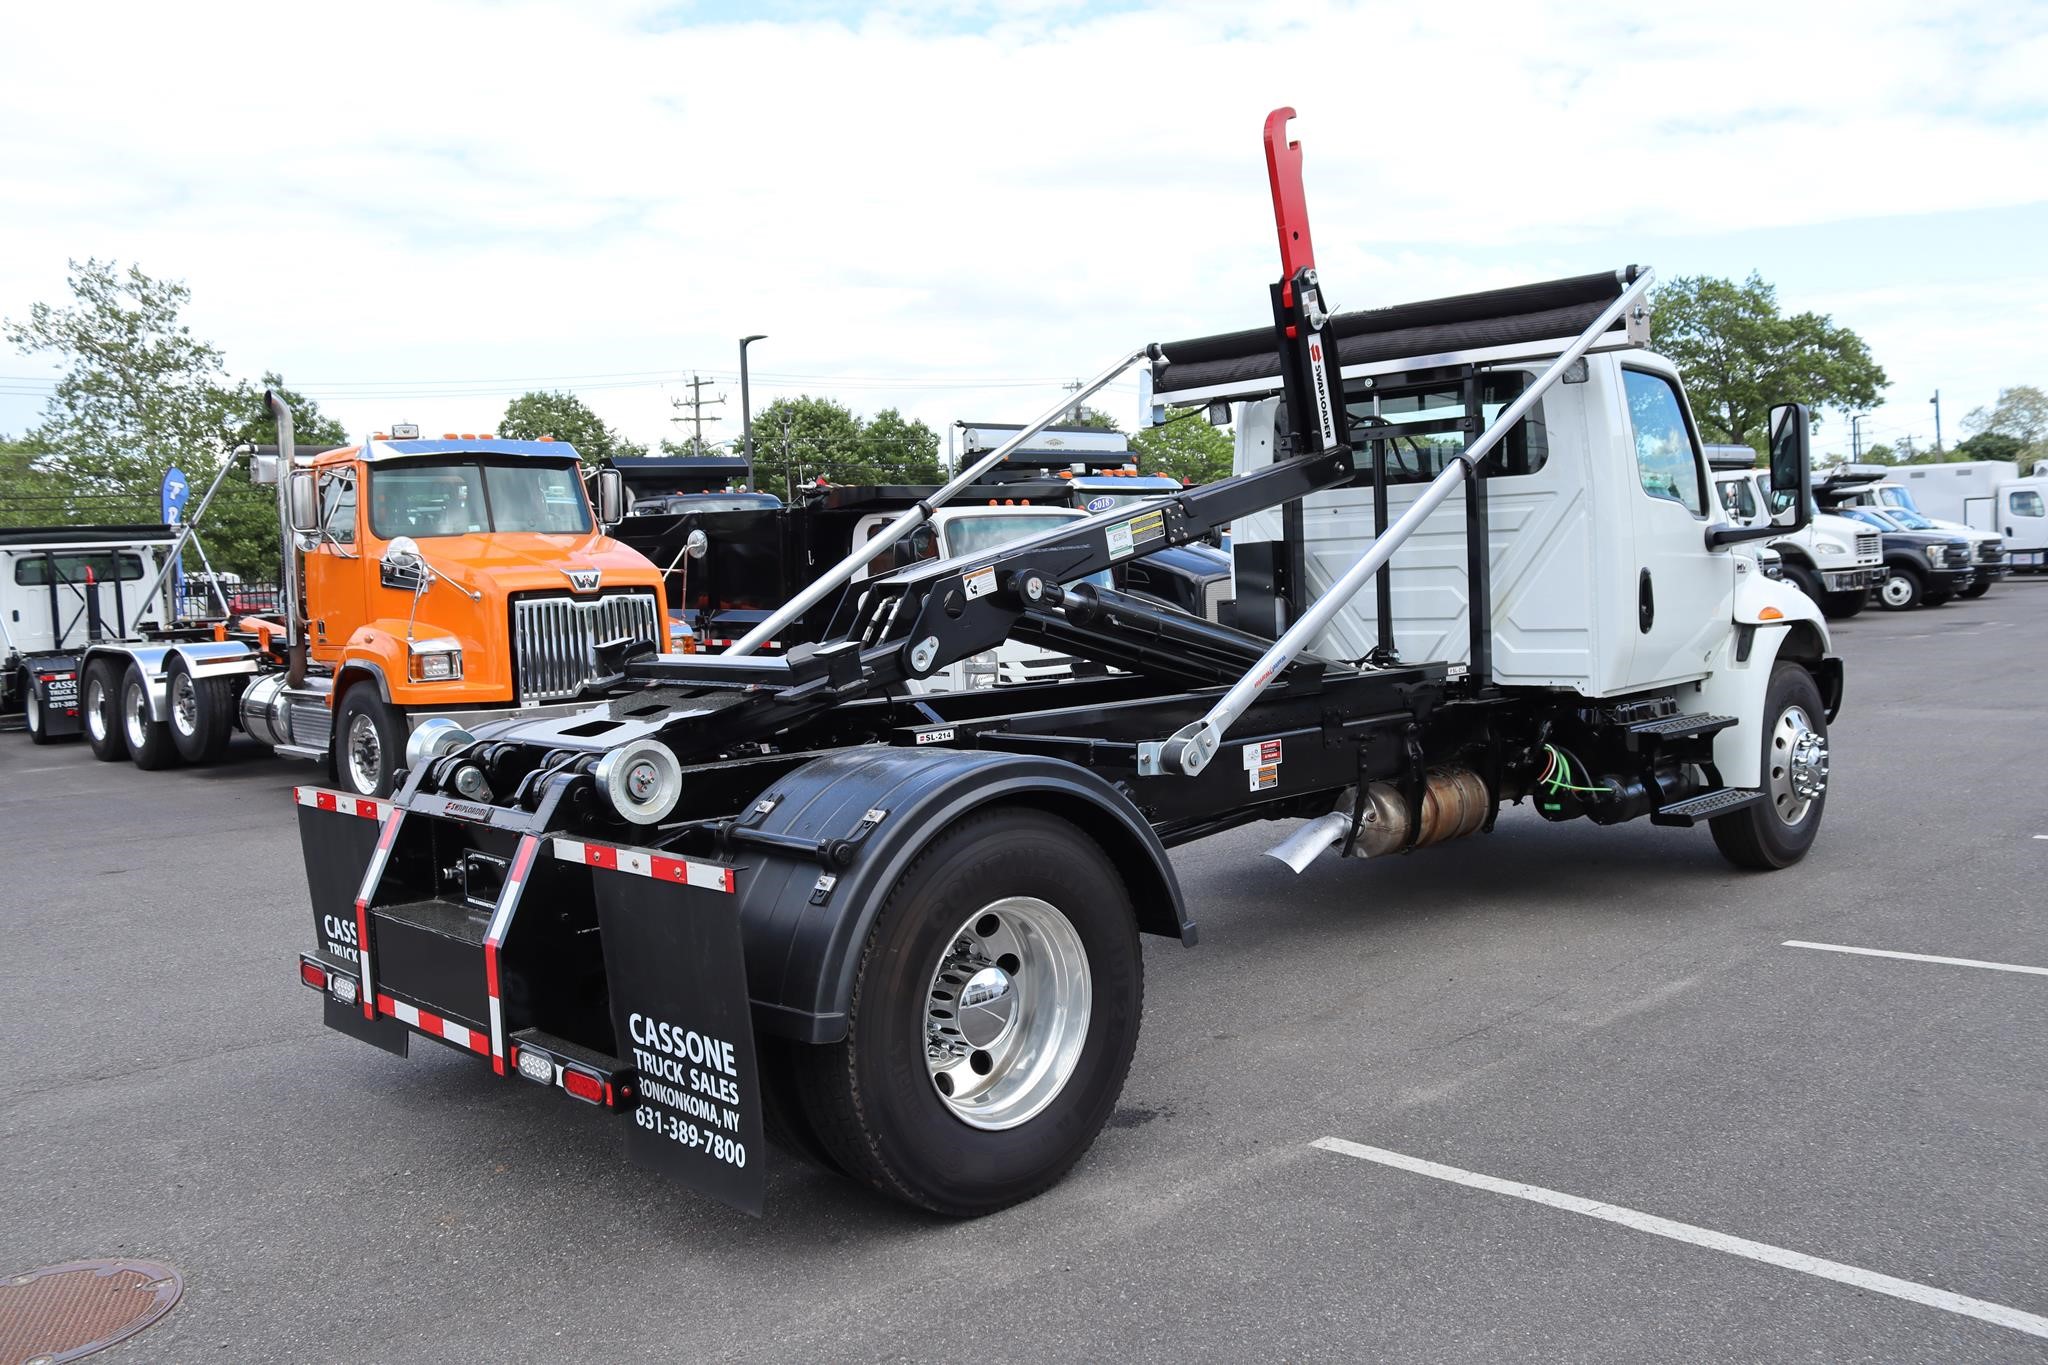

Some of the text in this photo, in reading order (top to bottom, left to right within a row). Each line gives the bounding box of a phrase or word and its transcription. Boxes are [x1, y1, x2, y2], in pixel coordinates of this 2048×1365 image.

[1315, 364, 1331, 439] SWAPLOADER
[1093, 498, 1110, 510] 2018
[925, 731, 951, 742] SL-214
[629, 1013, 737, 1077] CASSONE
[633, 1047, 740, 1105] TRUCK SALES
[635, 1104, 746, 1168] 631-389-7800
[723, 1108, 740, 1133] NY
